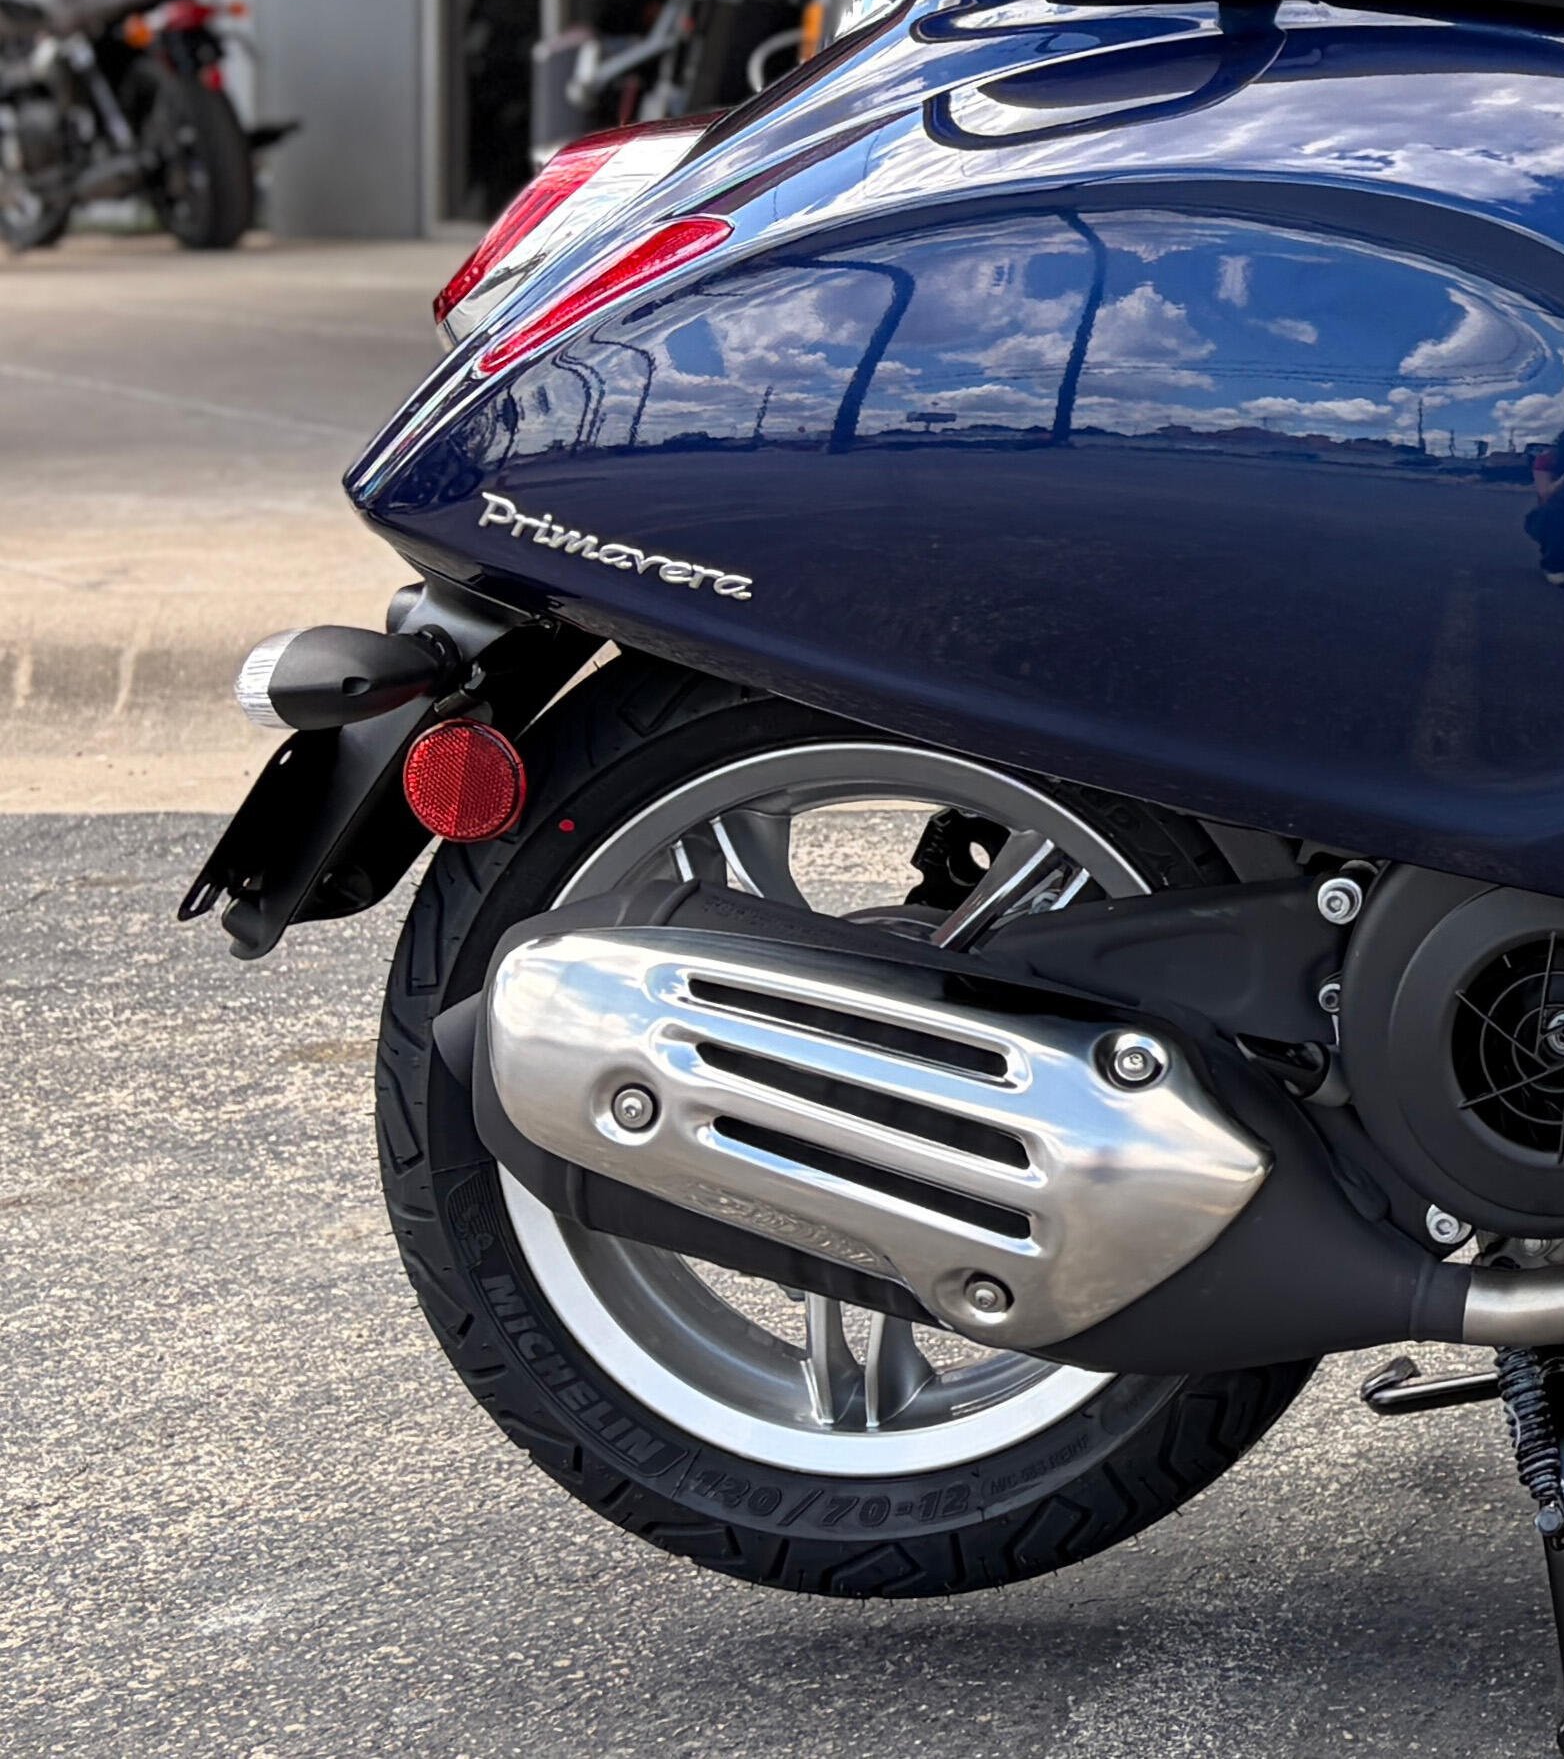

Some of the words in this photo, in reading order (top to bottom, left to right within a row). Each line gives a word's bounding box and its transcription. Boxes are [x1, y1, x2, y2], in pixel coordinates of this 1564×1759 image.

[478, 491, 753, 601] Primavera
[480, 1274, 666, 1468] MICHELIN
[694, 1470, 972, 1528] 120/70-12
